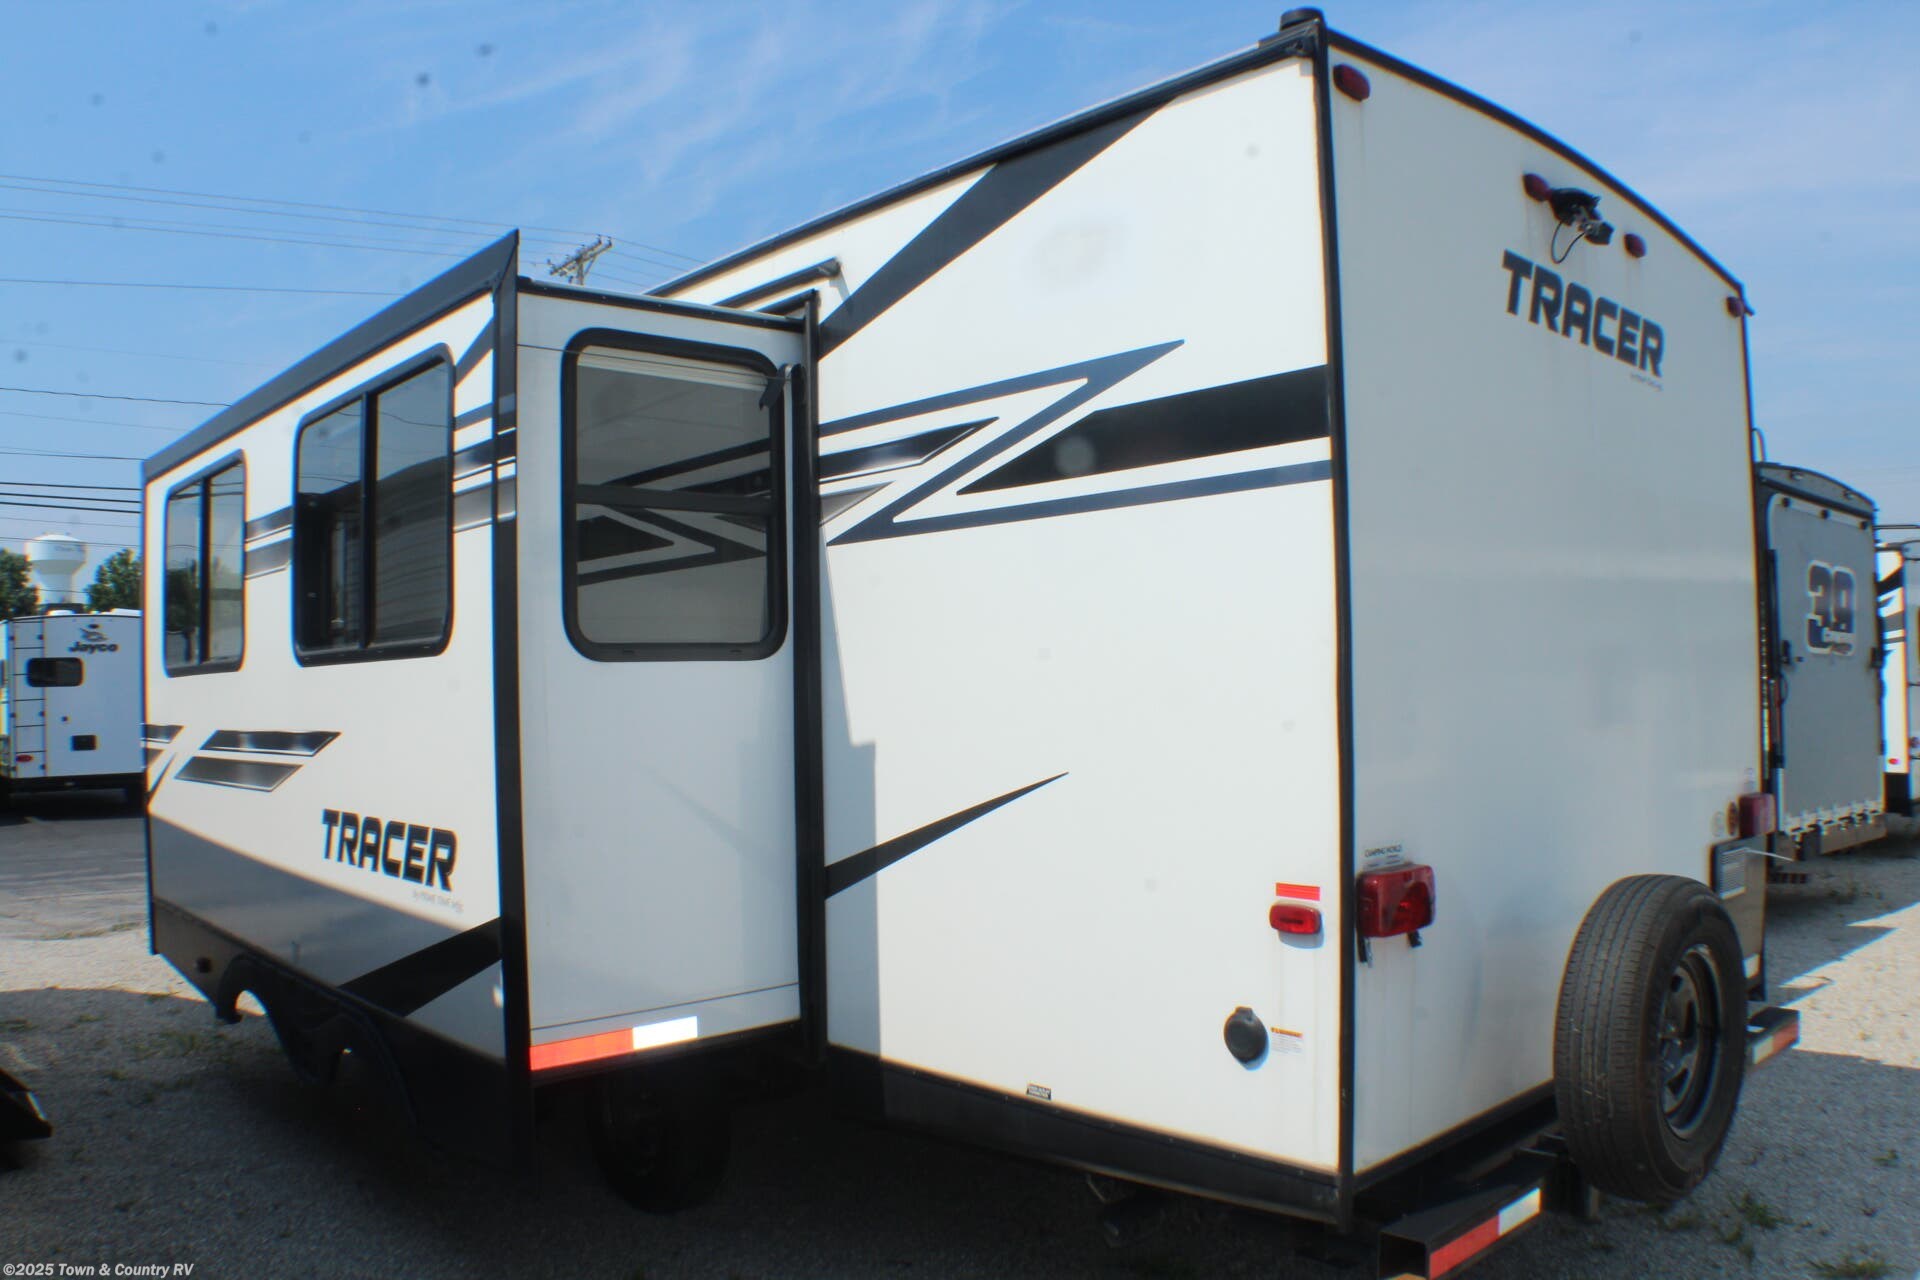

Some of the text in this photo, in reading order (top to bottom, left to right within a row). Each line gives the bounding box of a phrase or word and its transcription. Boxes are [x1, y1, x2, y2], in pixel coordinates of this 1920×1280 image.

[1502, 248, 1665, 378] TRACER
[68, 641, 119, 655] Jayco
[322, 808, 458, 892] TRACER
